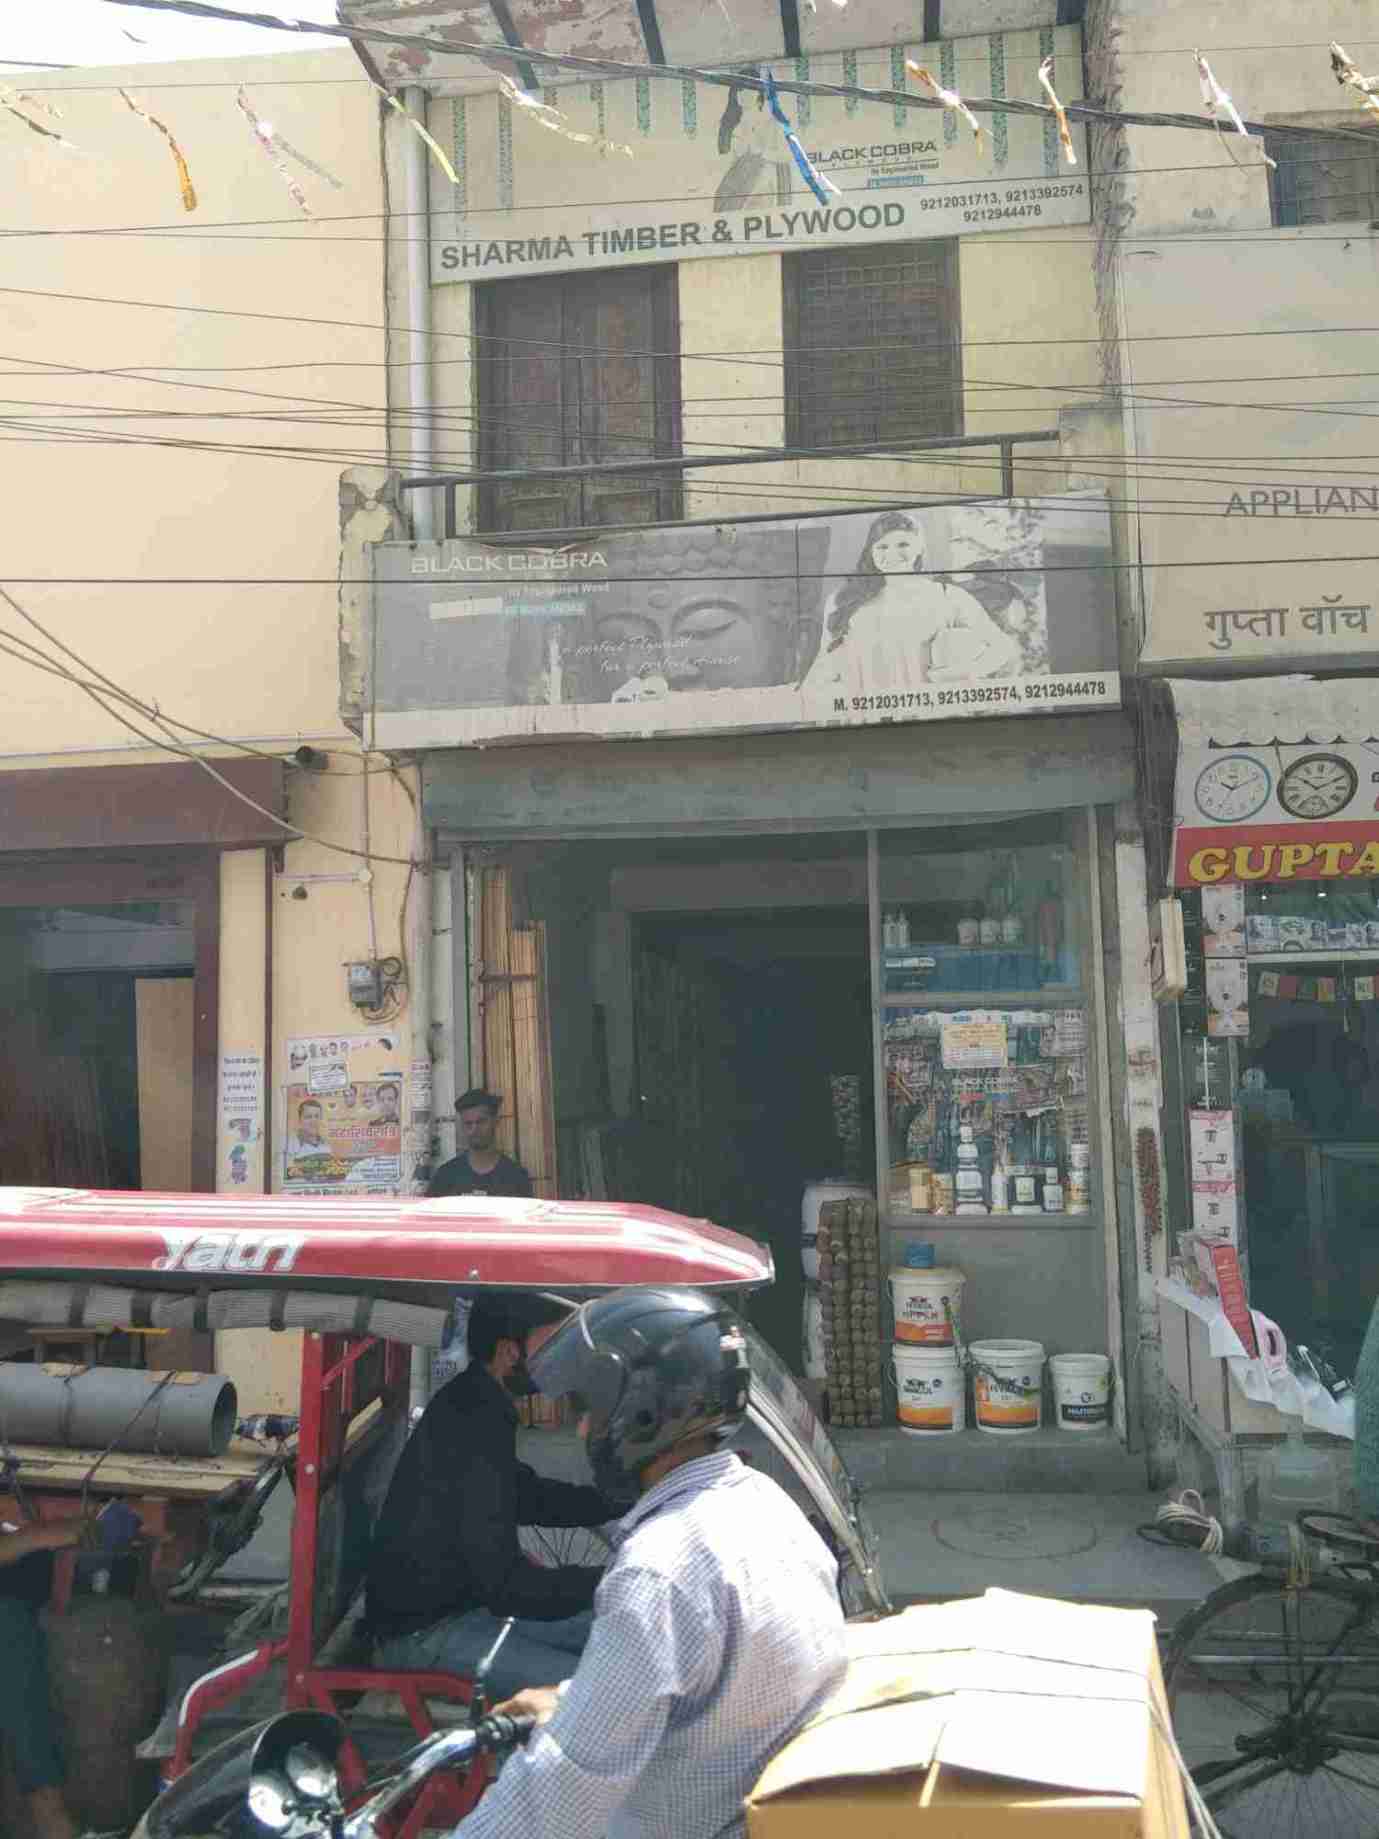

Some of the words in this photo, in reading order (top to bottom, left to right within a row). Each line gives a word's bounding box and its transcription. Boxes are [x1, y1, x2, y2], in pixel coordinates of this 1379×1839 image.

[808, 147, 867, 164] BLACK
[870, 140, 937, 158] COBRA
[441, 235, 575, 270] SHARMA
[582, 222, 702, 256] TIMBER
[711, 219, 733, 243] &
[743, 203, 905, 240] PLYWOOD
[411, 554, 503, 574] BLACK
[507, 551, 608, 570] COBRA
[1203, 608, 1290, 650] गुप्ता
[1298, 594, 1371, 635] वॉच
[834, 698, 849, 712] M.
[852, 692, 935, 711] 9212031713,
[937, 686, 1022, 705] 9213392574,
[1025, 681, 1106, 698] 9212944478
